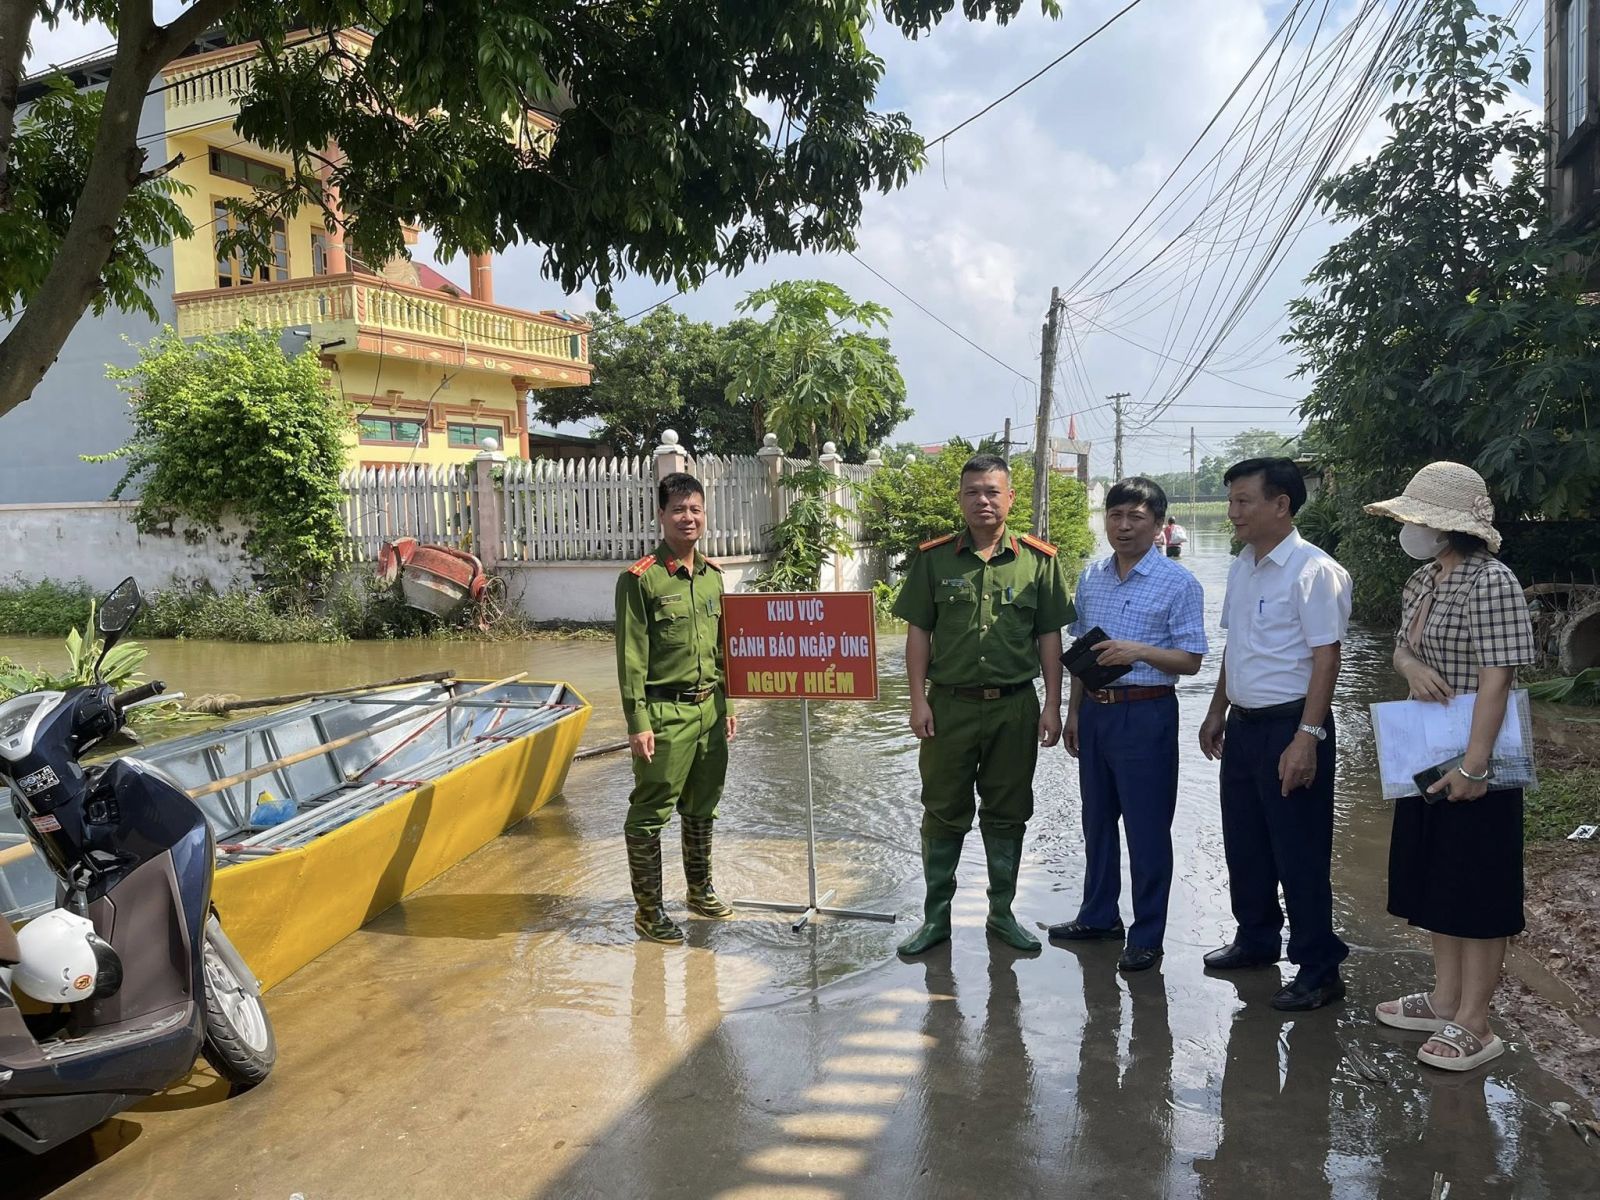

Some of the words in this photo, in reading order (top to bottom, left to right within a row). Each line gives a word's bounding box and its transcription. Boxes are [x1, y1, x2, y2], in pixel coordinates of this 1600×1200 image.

[767, 600, 794, 622] KHU
[798, 598, 824, 625] VỰC
[729, 628, 765, 657] CẢNH
[769, 632, 795, 657] BÁO
[799, 632, 836, 662] NGẬP
[840, 632, 869, 657] ÚNG
[746, 671, 798, 693] NGUY
[804, 663, 855, 694] HIỂM
